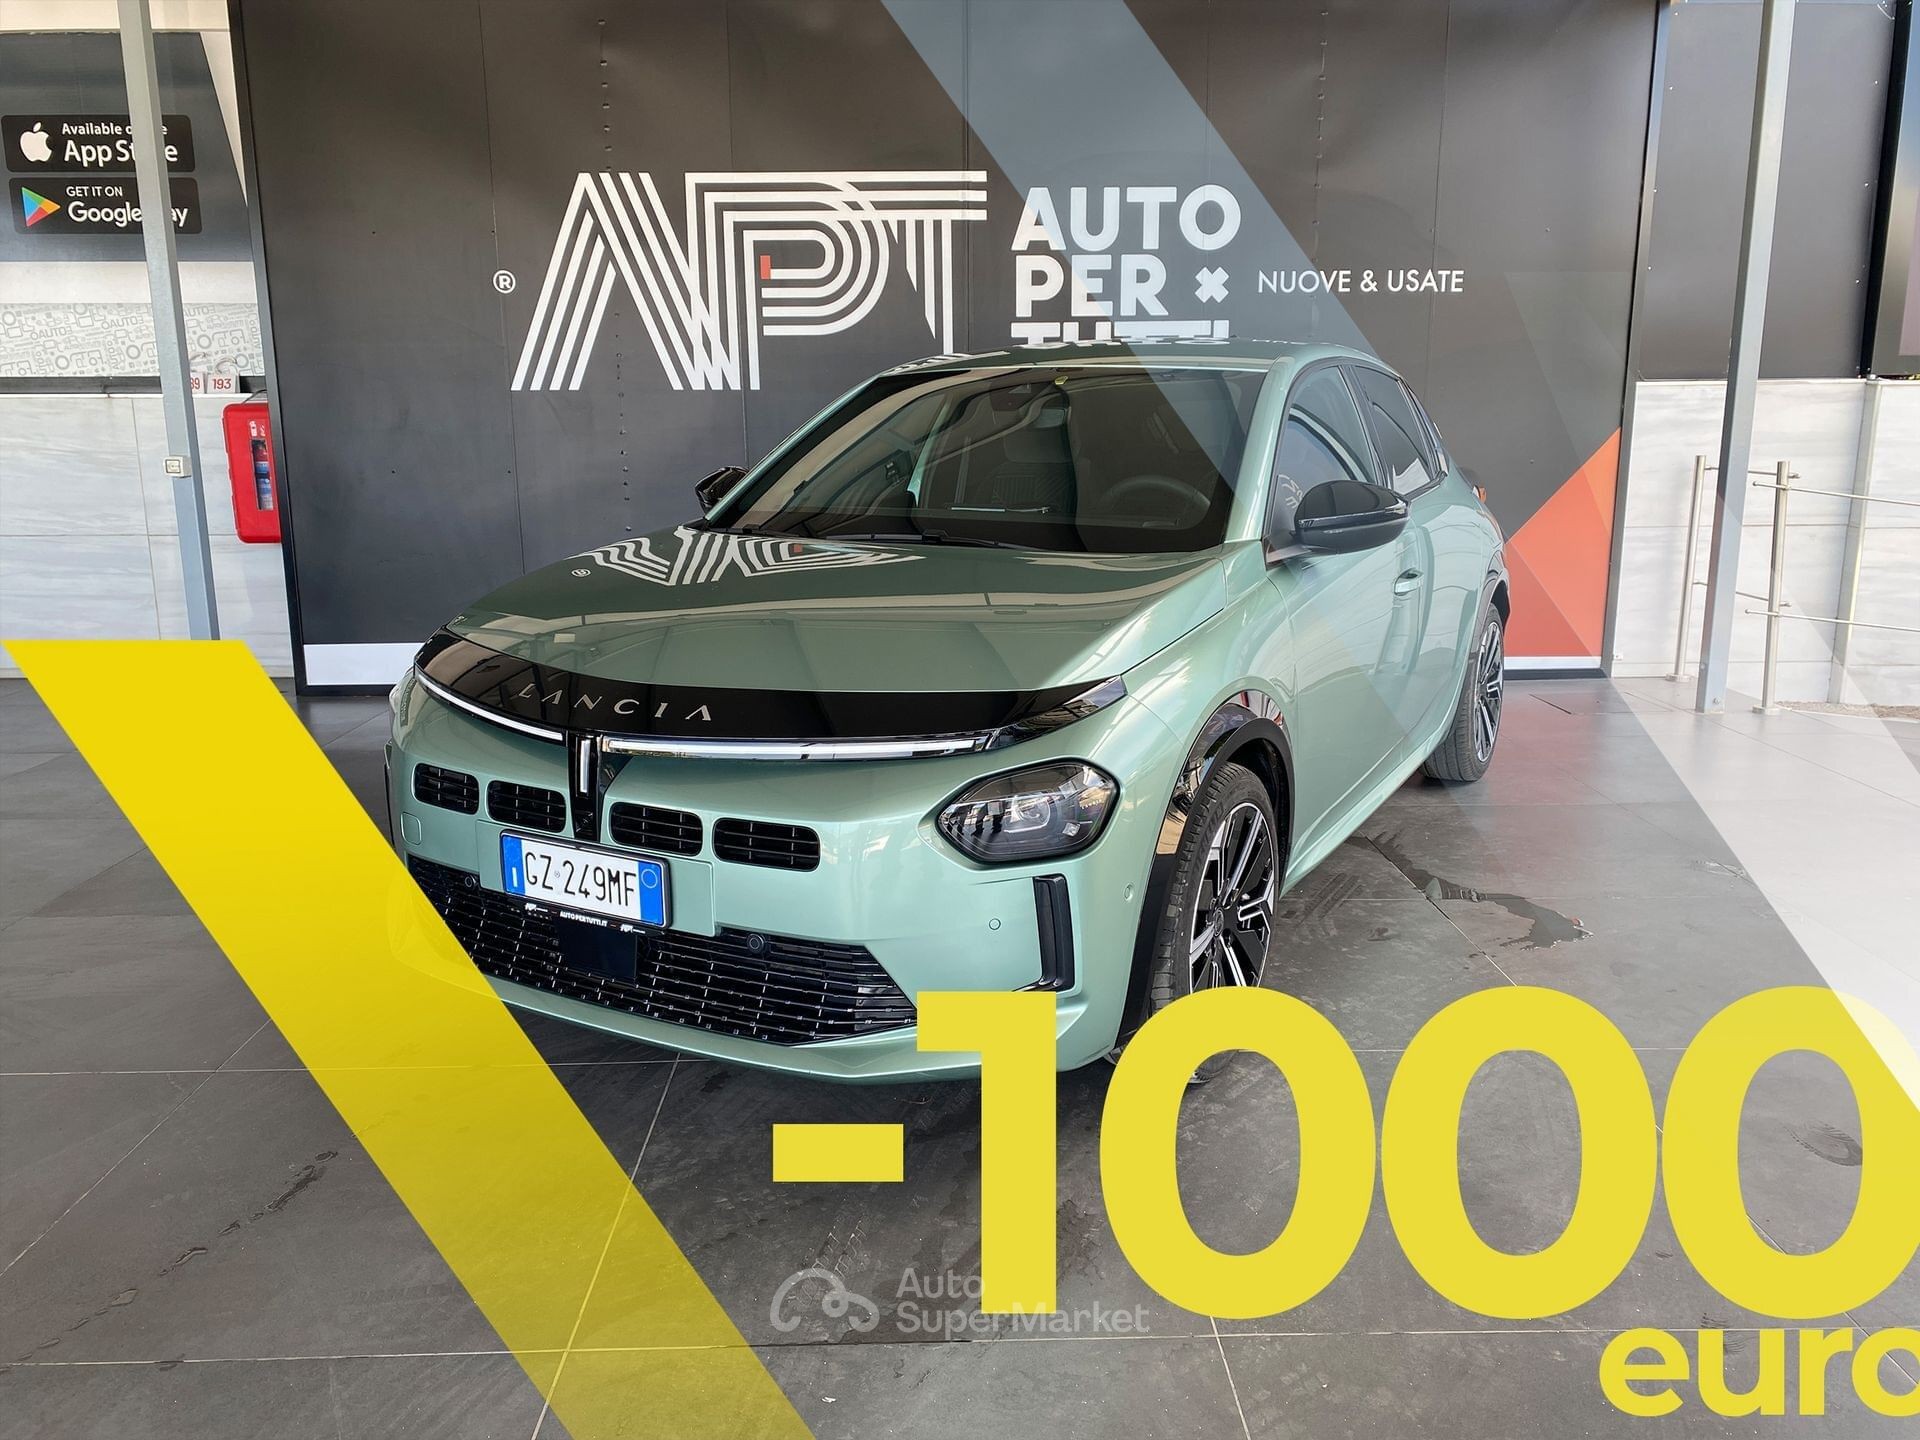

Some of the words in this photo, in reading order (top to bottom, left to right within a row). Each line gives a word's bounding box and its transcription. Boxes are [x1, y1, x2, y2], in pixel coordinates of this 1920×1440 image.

[62, 122, 122, 135] Available
[64, 139, 113, 168] App
[115, 139, 178, 162] Ste
[66, 186, 89, 197] GET
[92, 186, 103, 196] IT
[104, 186, 123, 197] ON
[67, 200, 142, 228] Google
[1011, 184, 1241, 251] AUTO
[1015, 254, 1168, 317] PER
[1258, 270, 1351, 293] NUOVE
[1360, 270, 1378, 293] &
[1387, 269, 1465, 293] USATE
[213, 378, 231, 390] 193
[518, 683, 712, 721] LANCIA
[524, 852, 554, 892] GZ
[562, 859, 637, 907] 249MF
